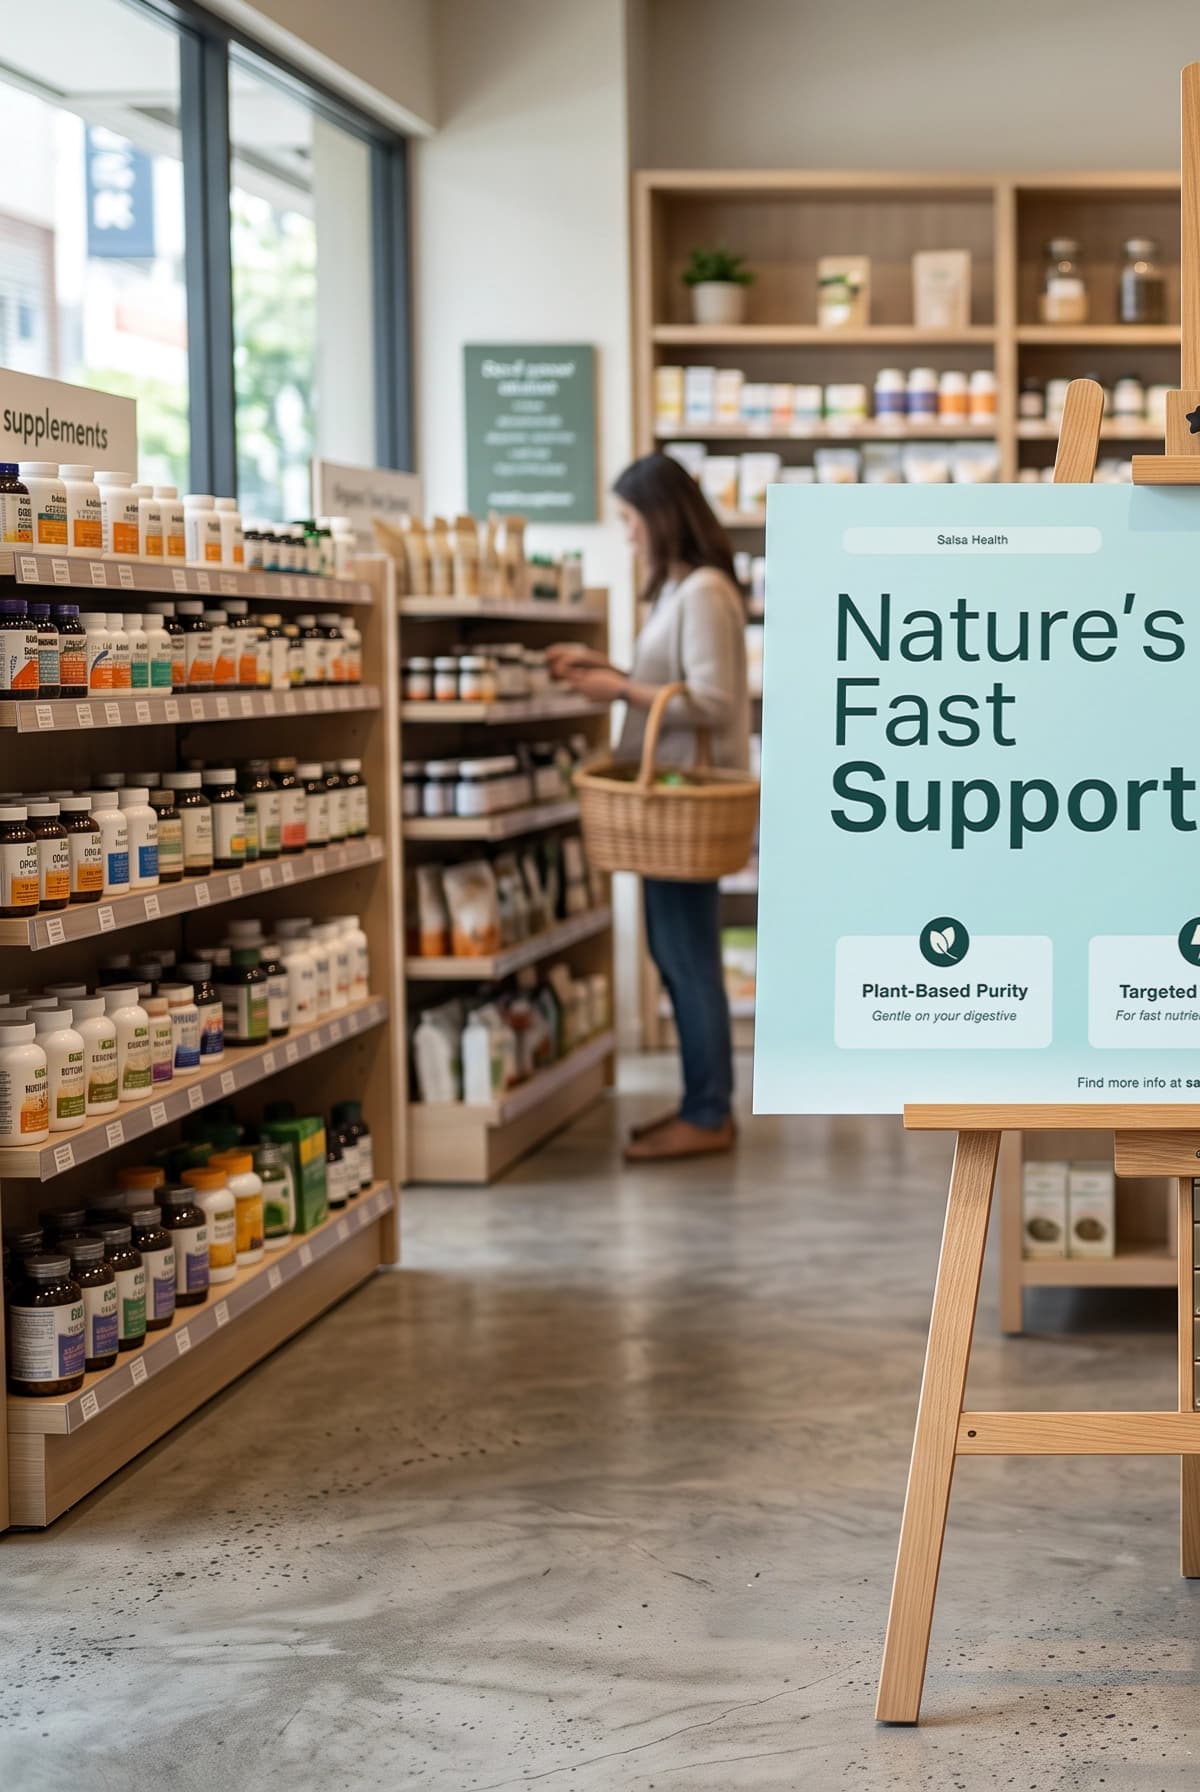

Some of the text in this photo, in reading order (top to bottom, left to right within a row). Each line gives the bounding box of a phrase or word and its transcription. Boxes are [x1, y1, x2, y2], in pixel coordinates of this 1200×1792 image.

[3, 407, 109, 450] supplements
[936, 534, 1009, 546] Salsa Health
[835, 677, 1017, 748] Fast
[830, 760, 1198, 850] Support
[862, 983, 1029, 1002] Plant-Based Purity
[1118, 983, 1198, 1003] Targeted
[871, 1009, 1017, 1024] Gentle on your digestive
[1115, 1009, 1137, 1022] For
[1139, 1009, 1162, 1022] fast
[1077, 1076, 1105, 1089] Find
[1107, 1079, 1140, 1089] more
[1143, 1076, 1167, 1089] info
[1169, 1077, 1182, 1089] at
